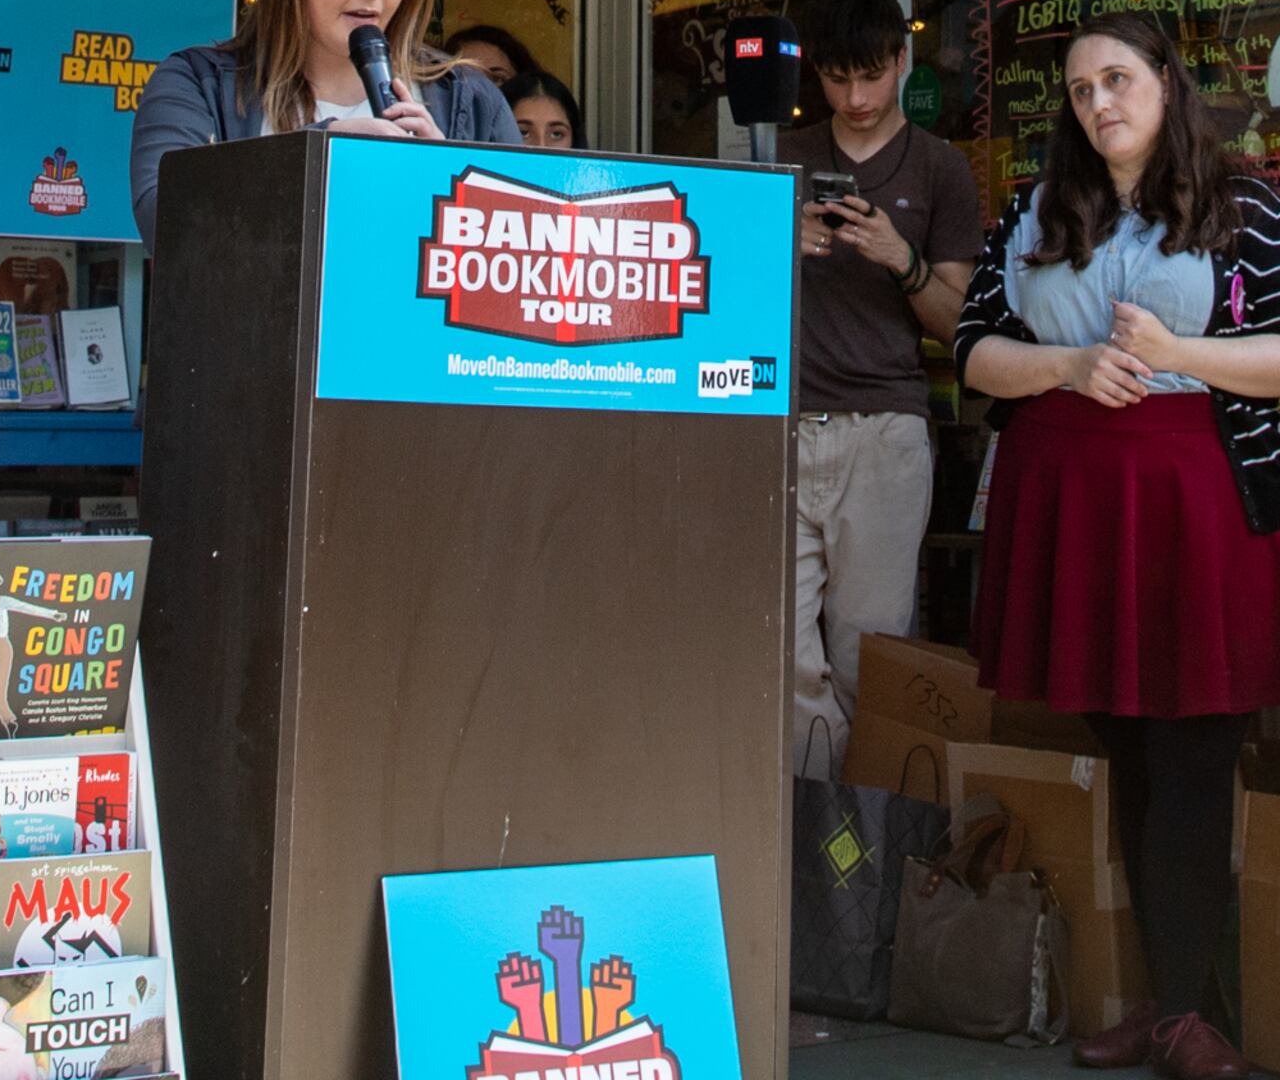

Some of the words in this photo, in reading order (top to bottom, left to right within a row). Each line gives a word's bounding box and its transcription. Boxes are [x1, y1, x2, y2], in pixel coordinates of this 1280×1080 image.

[1017, 0, 1082, 34] LGBTQ
[75, 34, 131, 60] READ
[740, 42, 758, 52] ntv
[62, 57, 156, 85] BANN
[442, 206, 691, 260] BANNED
[428, 250, 702, 304] BOOKMOBILE
[521, 301, 612, 326] TOUR
[448, 354, 676, 384] MoveOnBannedBookmobile.com
[10, 566, 134, 602] FREEDOM
[74, 609, 90, 623] IN
[25, 624, 124, 655] CONGO
[19, 659, 122, 694] SQUARE
[5, 786, 18, 806] b.
[20, 787, 70, 811] jones
[17, 833, 60, 846] Smelly
[4, 871, 132, 931] MAUS
[50, 988, 94, 1015] Can
[106, 981, 114, 1007] I
[29, 1017, 127, 1051] TOUCH
[52, 1056, 96, 1080] Your
